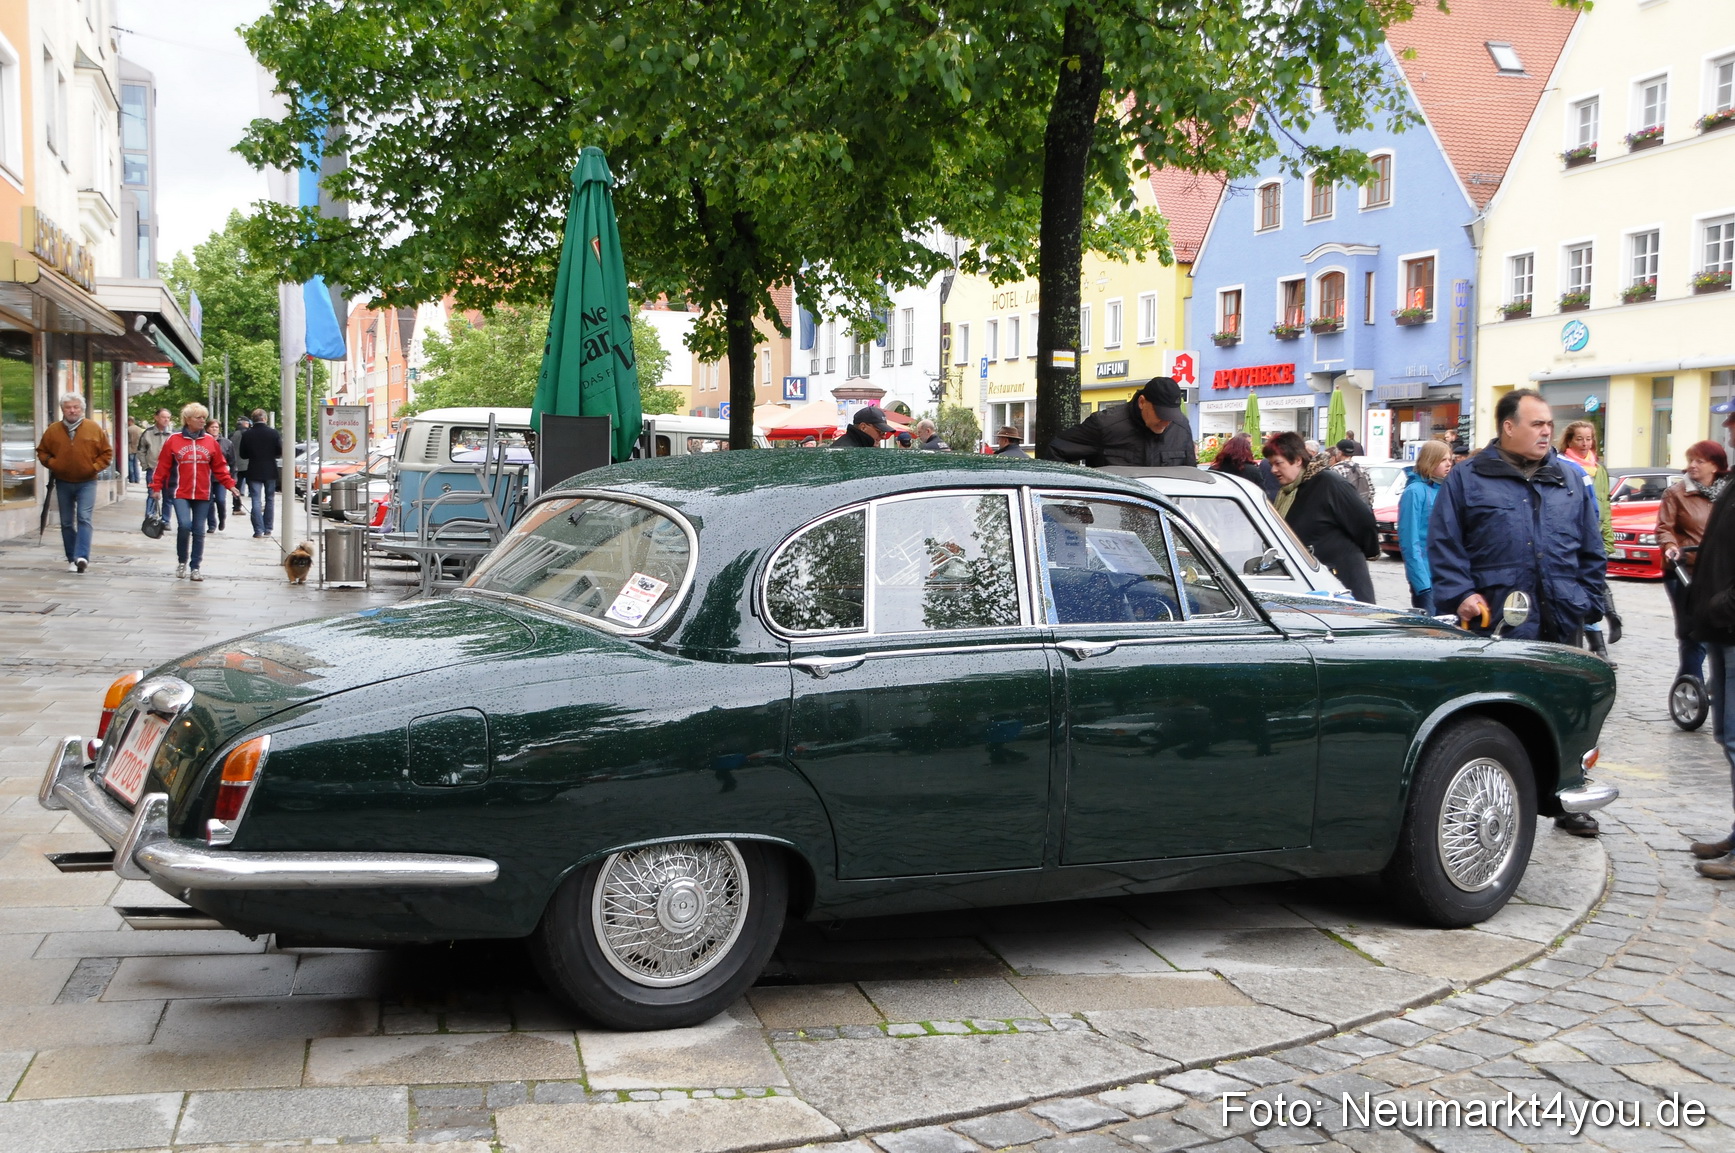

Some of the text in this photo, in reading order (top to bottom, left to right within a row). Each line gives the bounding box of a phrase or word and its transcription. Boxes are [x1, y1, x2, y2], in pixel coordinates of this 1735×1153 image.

[991, 291, 1019, 311] HOTEL
[1095, 362, 1124, 377] TAIFUN
[1211, 363, 1296, 390] APOTHEKE
[988, 381, 1026, 395] Restaurant
